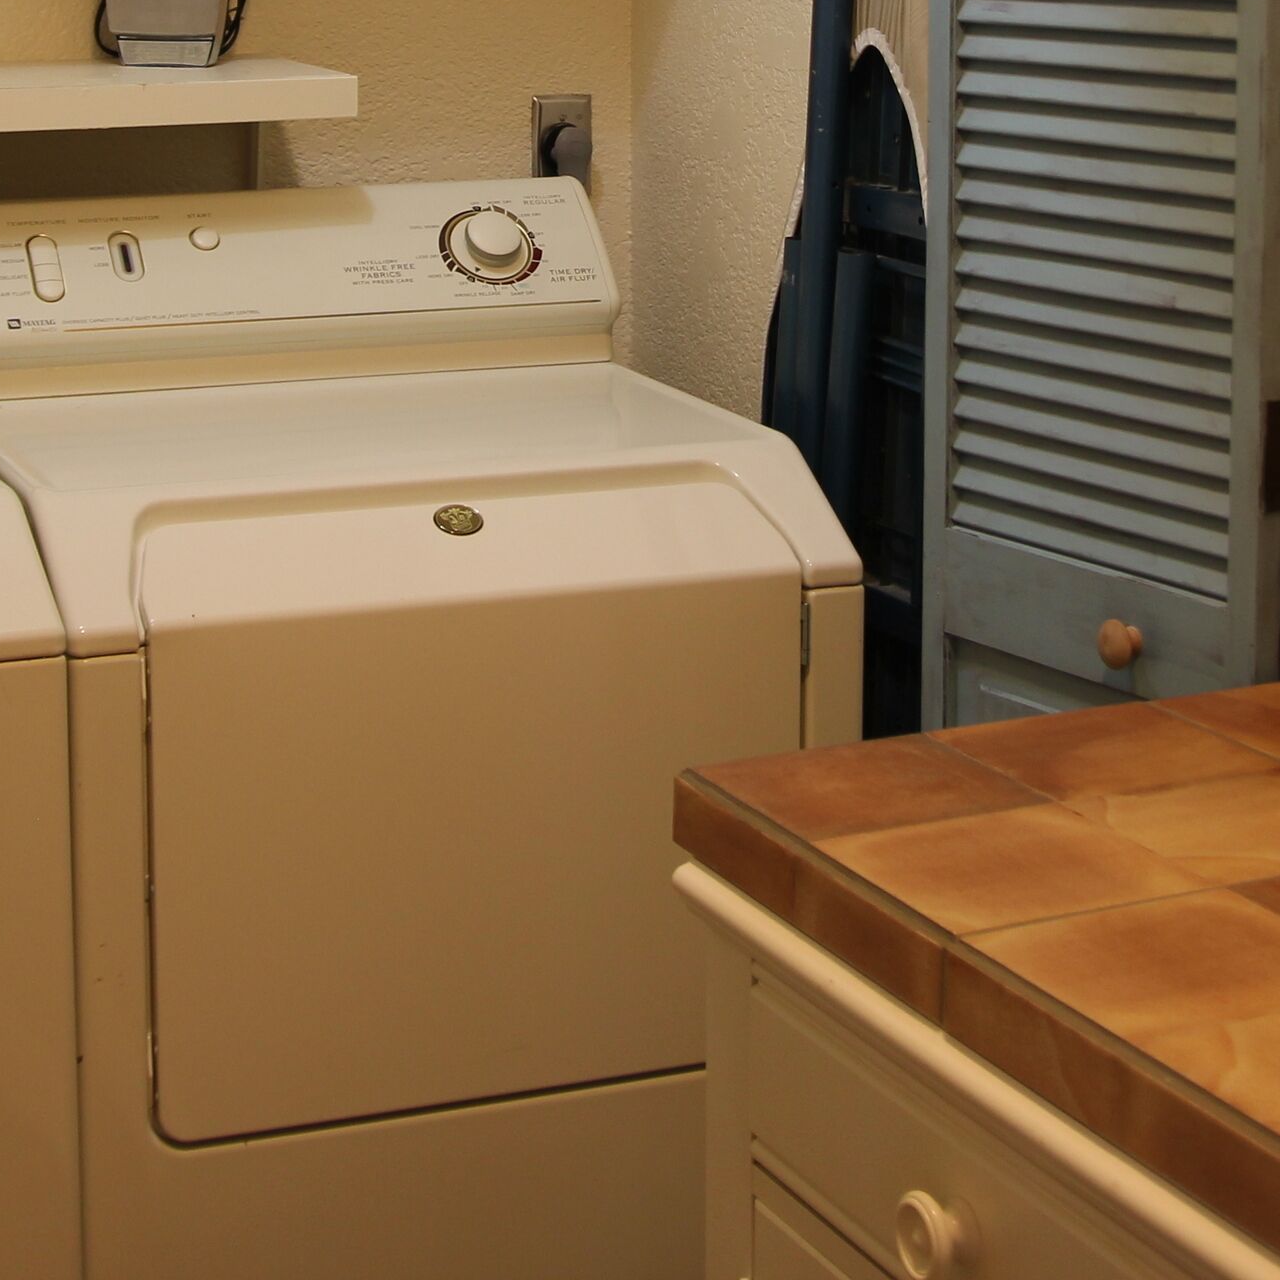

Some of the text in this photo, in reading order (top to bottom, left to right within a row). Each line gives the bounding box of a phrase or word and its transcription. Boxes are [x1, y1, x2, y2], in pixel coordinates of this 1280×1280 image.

[343, 263, 416, 273] WRINKLE FREE
[361, 271, 402, 279] FABRICS
[22, 319, 56, 327] MAYTAG
